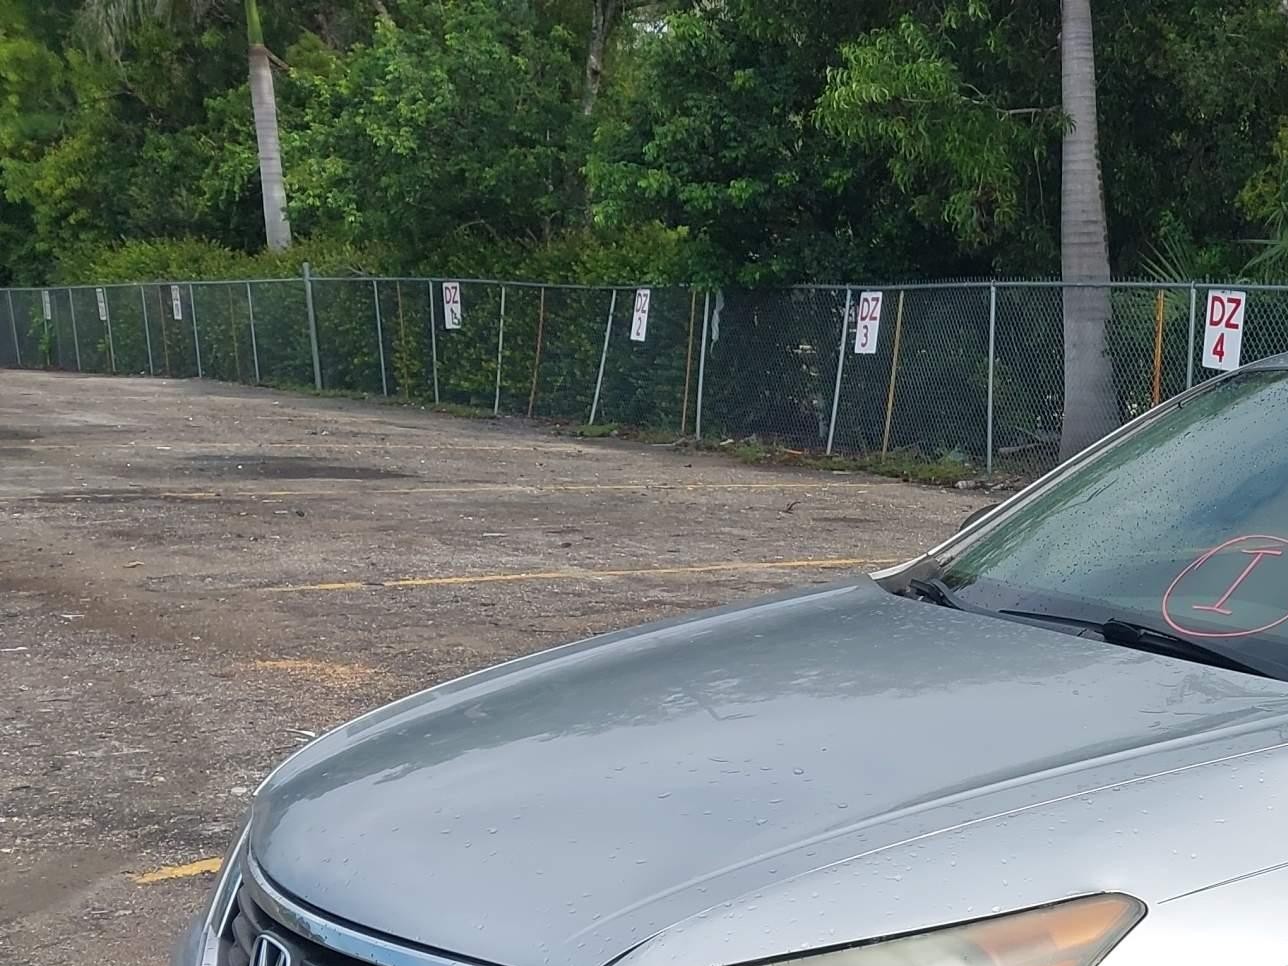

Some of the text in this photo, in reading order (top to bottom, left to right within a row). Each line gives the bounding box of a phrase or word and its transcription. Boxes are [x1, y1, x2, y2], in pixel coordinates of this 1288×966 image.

[444, 286, 459, 304] DZ
[636, 292, 648, 313] DZ
[860, 297, 880, 321] DZ
[1209, 296, 1242, 329] DZ
[861, 325, 869, 347] 3
[1212, 332, 1225, 363] 4
